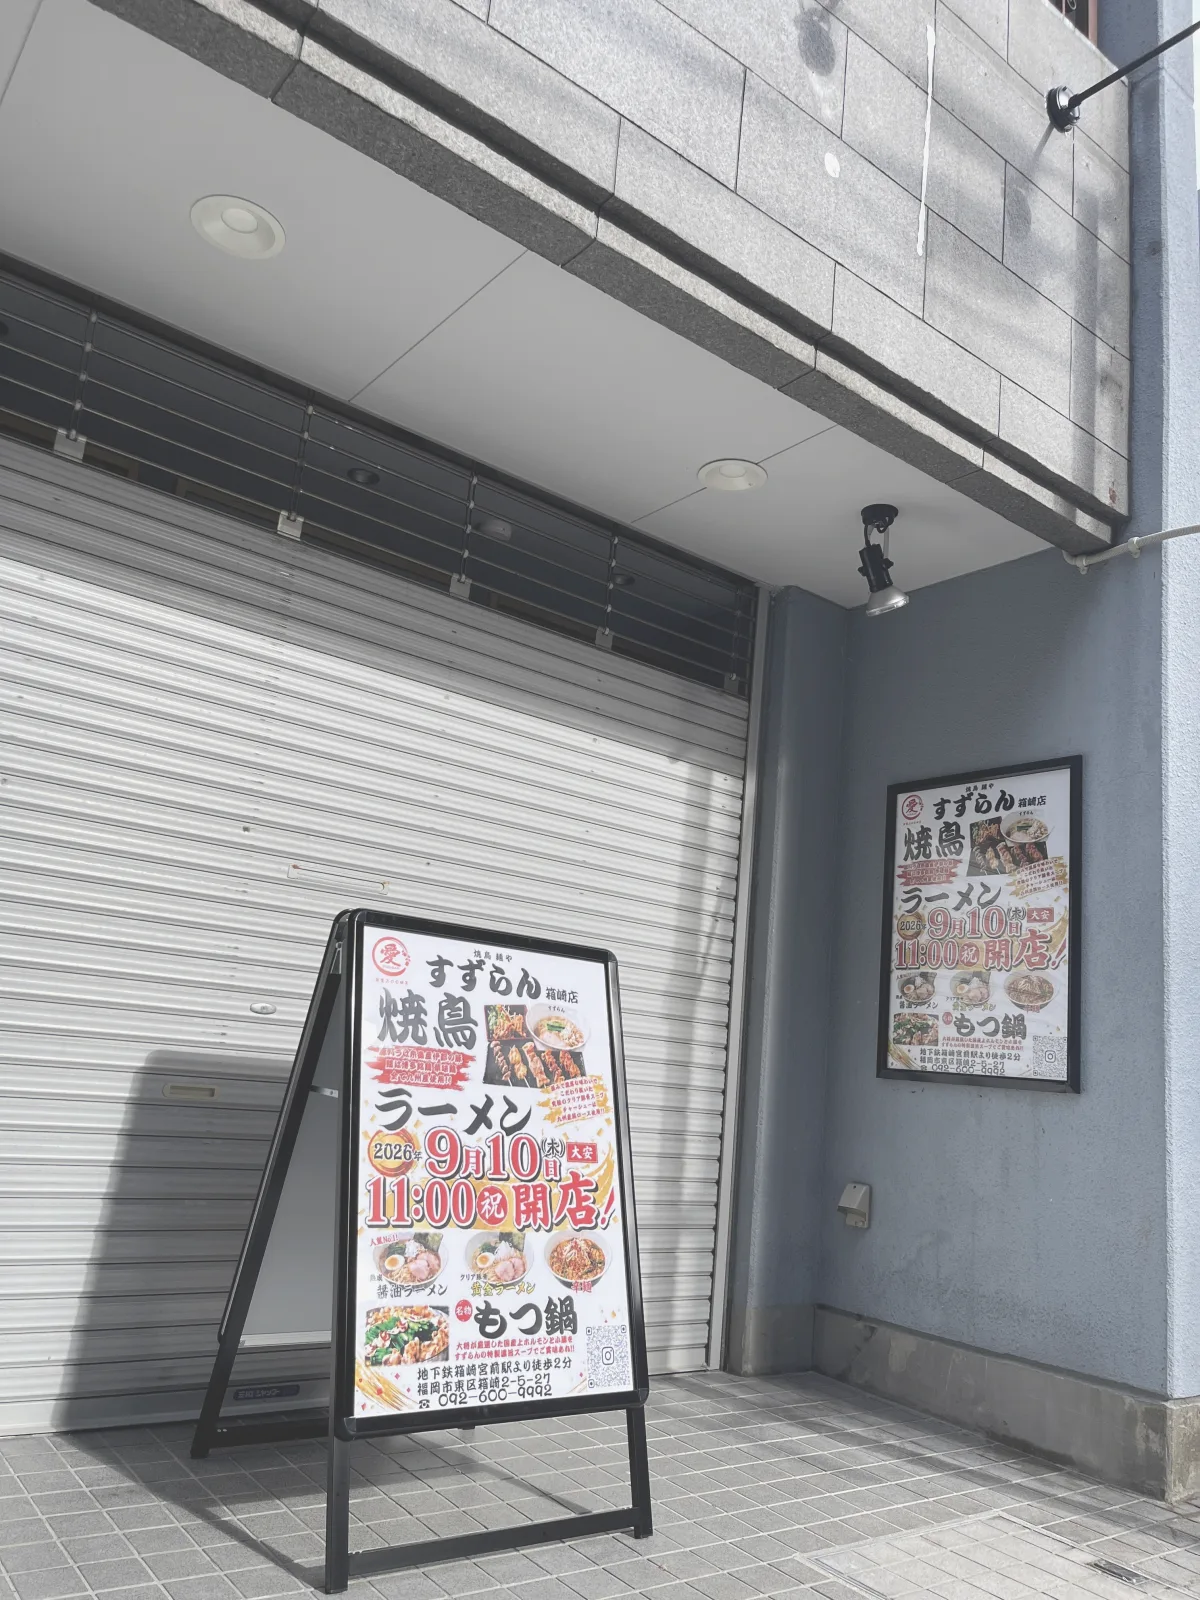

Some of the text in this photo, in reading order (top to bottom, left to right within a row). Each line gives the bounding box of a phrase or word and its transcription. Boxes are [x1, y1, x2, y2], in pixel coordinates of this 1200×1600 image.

[933, 790, 1014, 820] すずらん
[1018, 795, 1047, 808] 箱崎店
[903, 821, 965, 861] 焼鳥
[901, 882, 1001, 913] ラーメン
[1031, 910, 1050, 920] 大安
[380, 943, 402, 968] 愛
[895, 939, 957, 969] 11:00
[983, 928, 1067, 971] 開店!
[425, 954, 541, 999] すずらん
[546, 987, 578, 1004] 箱崎店
[377, 987, 479, 1050] 焼鳥
[953, 1013, 1027, 1040] もつ鍋
[374, 1088, 532, 1136] ラーメン
[374, 1142, 422, 1162] 2026年
[571, 1145, 593, 1160] 大安
[365, 1175, 477, 1229] 11:00
[512, 1170, 616, 1230] 開店!
[377, 1283, 449, 1299] 醤油ラーメン
[470, 1281, 536, 1298] 黄金ラーメン
[456, 1295, 578, 1339] 名物 もつ鍋
[417, 1356, 572, 1381] 地下鉄箱崎宮前駅より徒歩2分
[417, 1373, 552, 1397] 福岡市東区箱崎2-5-27
[438, 1384, 553, 1407] 092-600-9992
